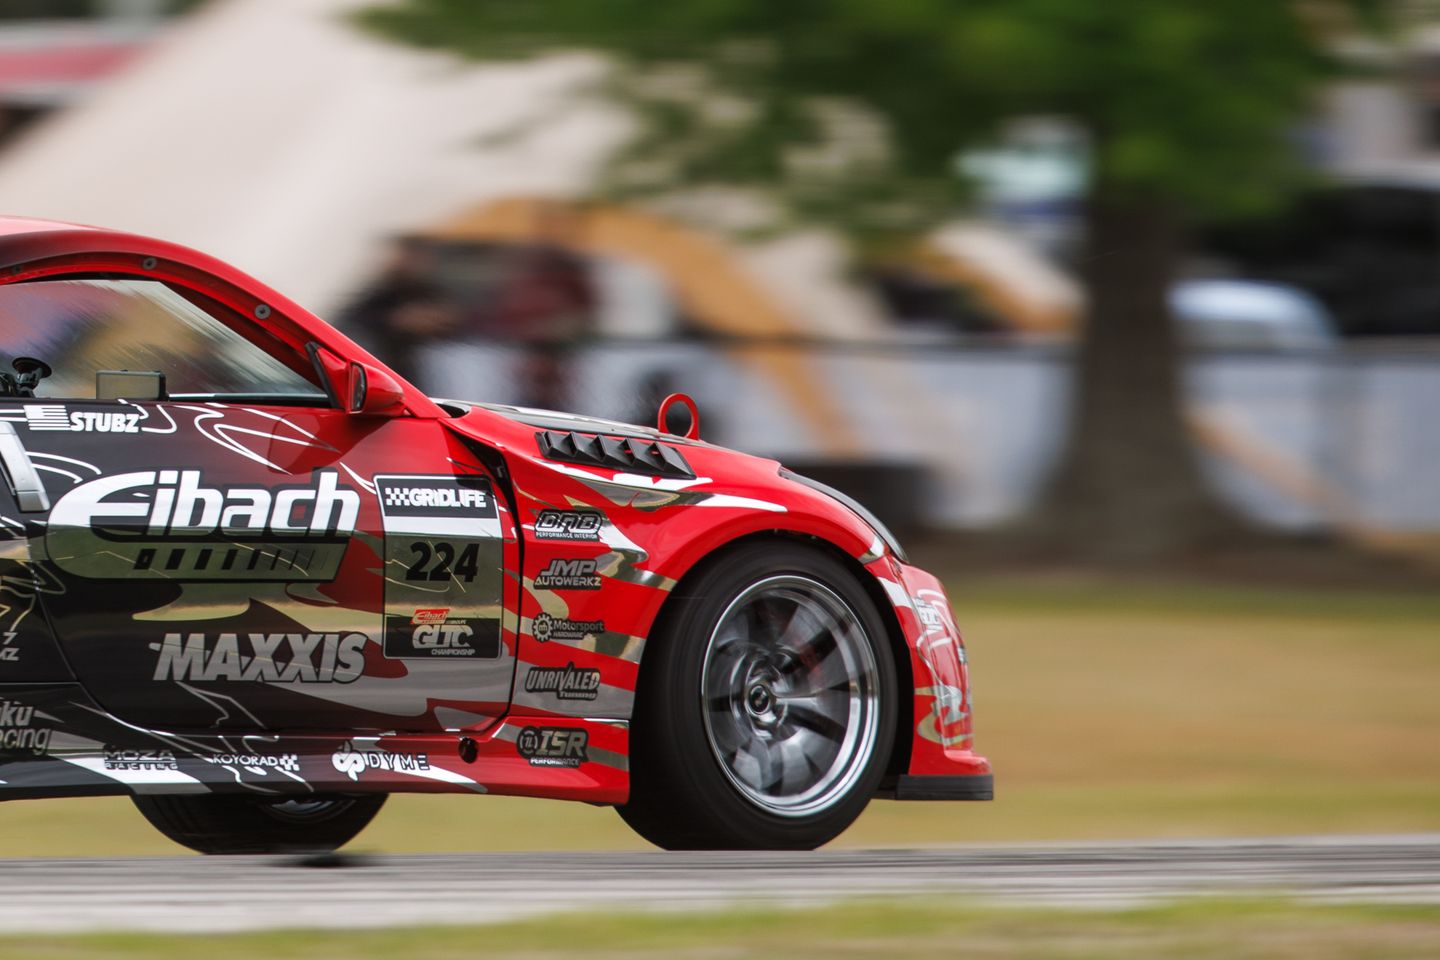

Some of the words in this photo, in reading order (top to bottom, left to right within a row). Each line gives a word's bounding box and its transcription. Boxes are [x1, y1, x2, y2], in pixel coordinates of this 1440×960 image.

[70, 412, 140, 433] STUBZ
[410, 489, 487, 508] GRIDLIFE
[47, 470, 360, 578] Eibach
[406, 542, 480, 582] 224
[540, 560, 597, 576] JMP
[534, 577, 602, 586] AUTOWERKZ
[553, 620, 604, 632] Motorsport
[154, 632, 367, 683] MAXXIS
[526, 664, 601, 692] UNRIVALED
[536, 730, 587, 756] ISR
[213, 754, 278, 767] KOYORAD
[367, 754, 430, 771] DYME
